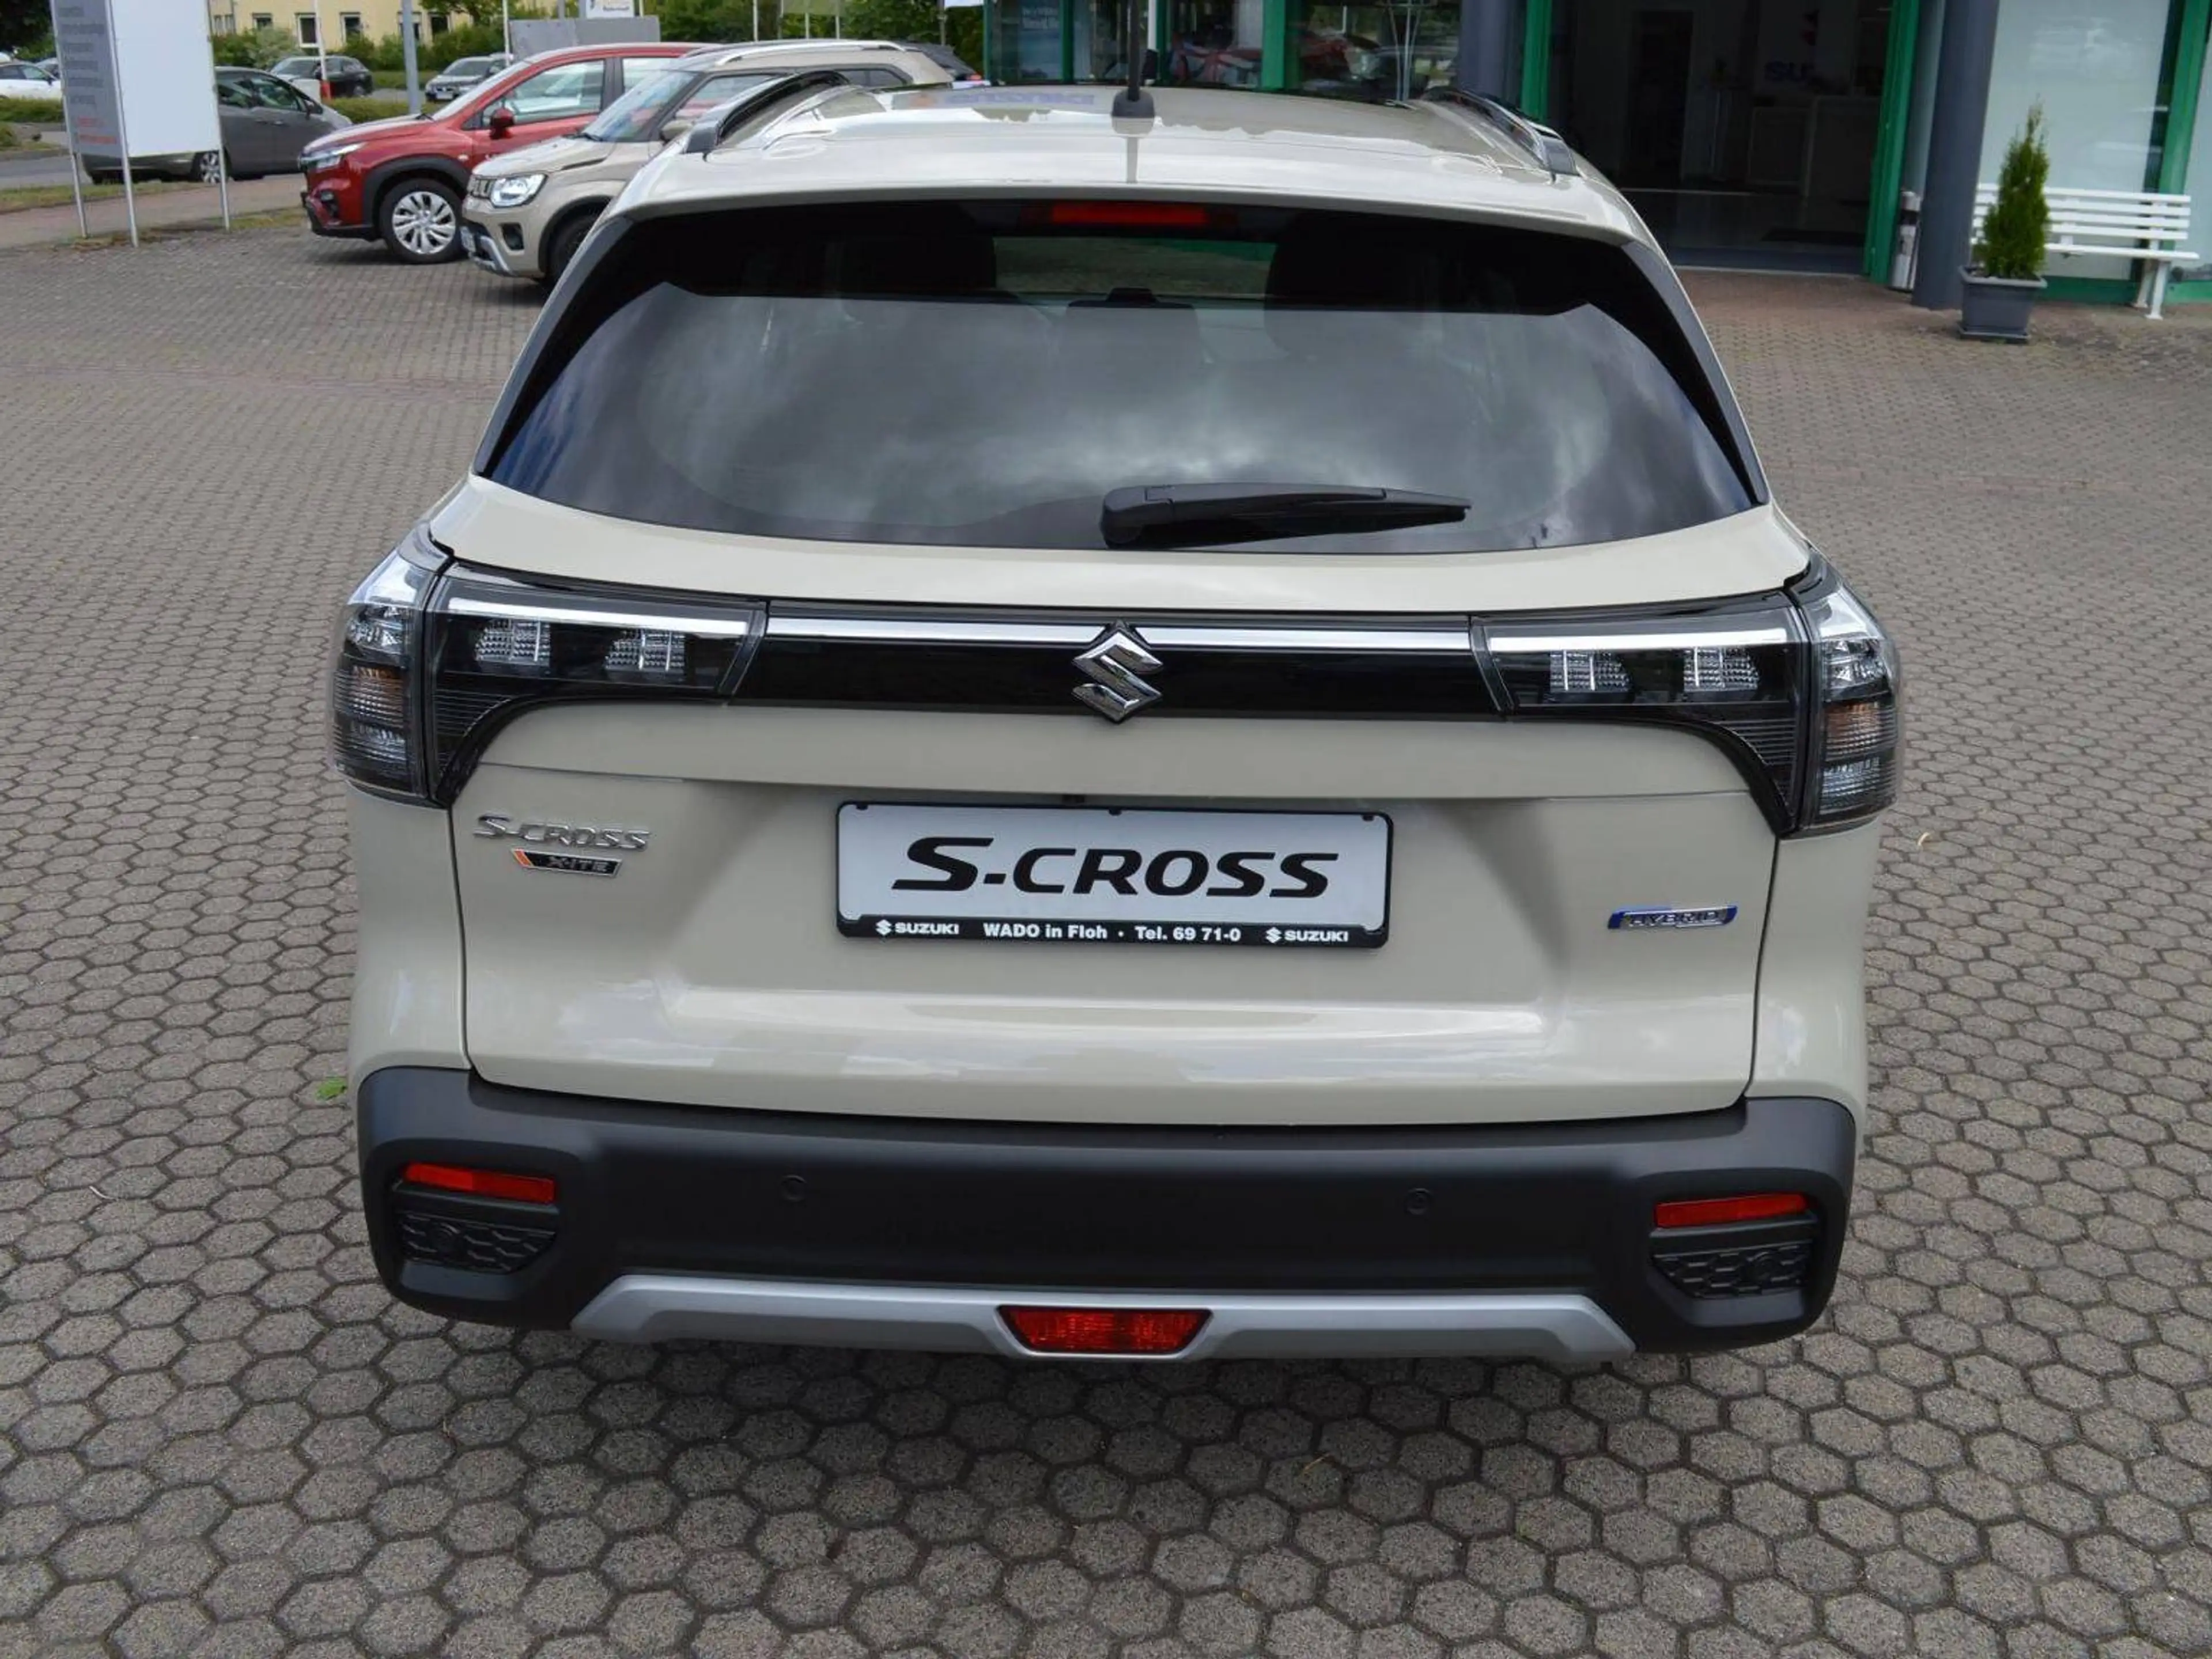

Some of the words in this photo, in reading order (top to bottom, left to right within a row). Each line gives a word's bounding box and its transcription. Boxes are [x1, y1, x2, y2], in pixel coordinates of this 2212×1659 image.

[474, 814, 650, 851] S-CROSS
[891, 837, 1339, 898] S-CROSS
[894, 923, 959, 935] SUZUKI
[983, 923, 1038, 938] WADO
[1045, 923, 1062, 938] in
[1068, 925, 1107, 939] Floh
[1135, 926, 1167, 940] Tel.
[1173, 927, 1196, 941] 69
[1202, 928, 1241, 942] 71-0
[1284, 930, 1348, 942] SUZUKI
